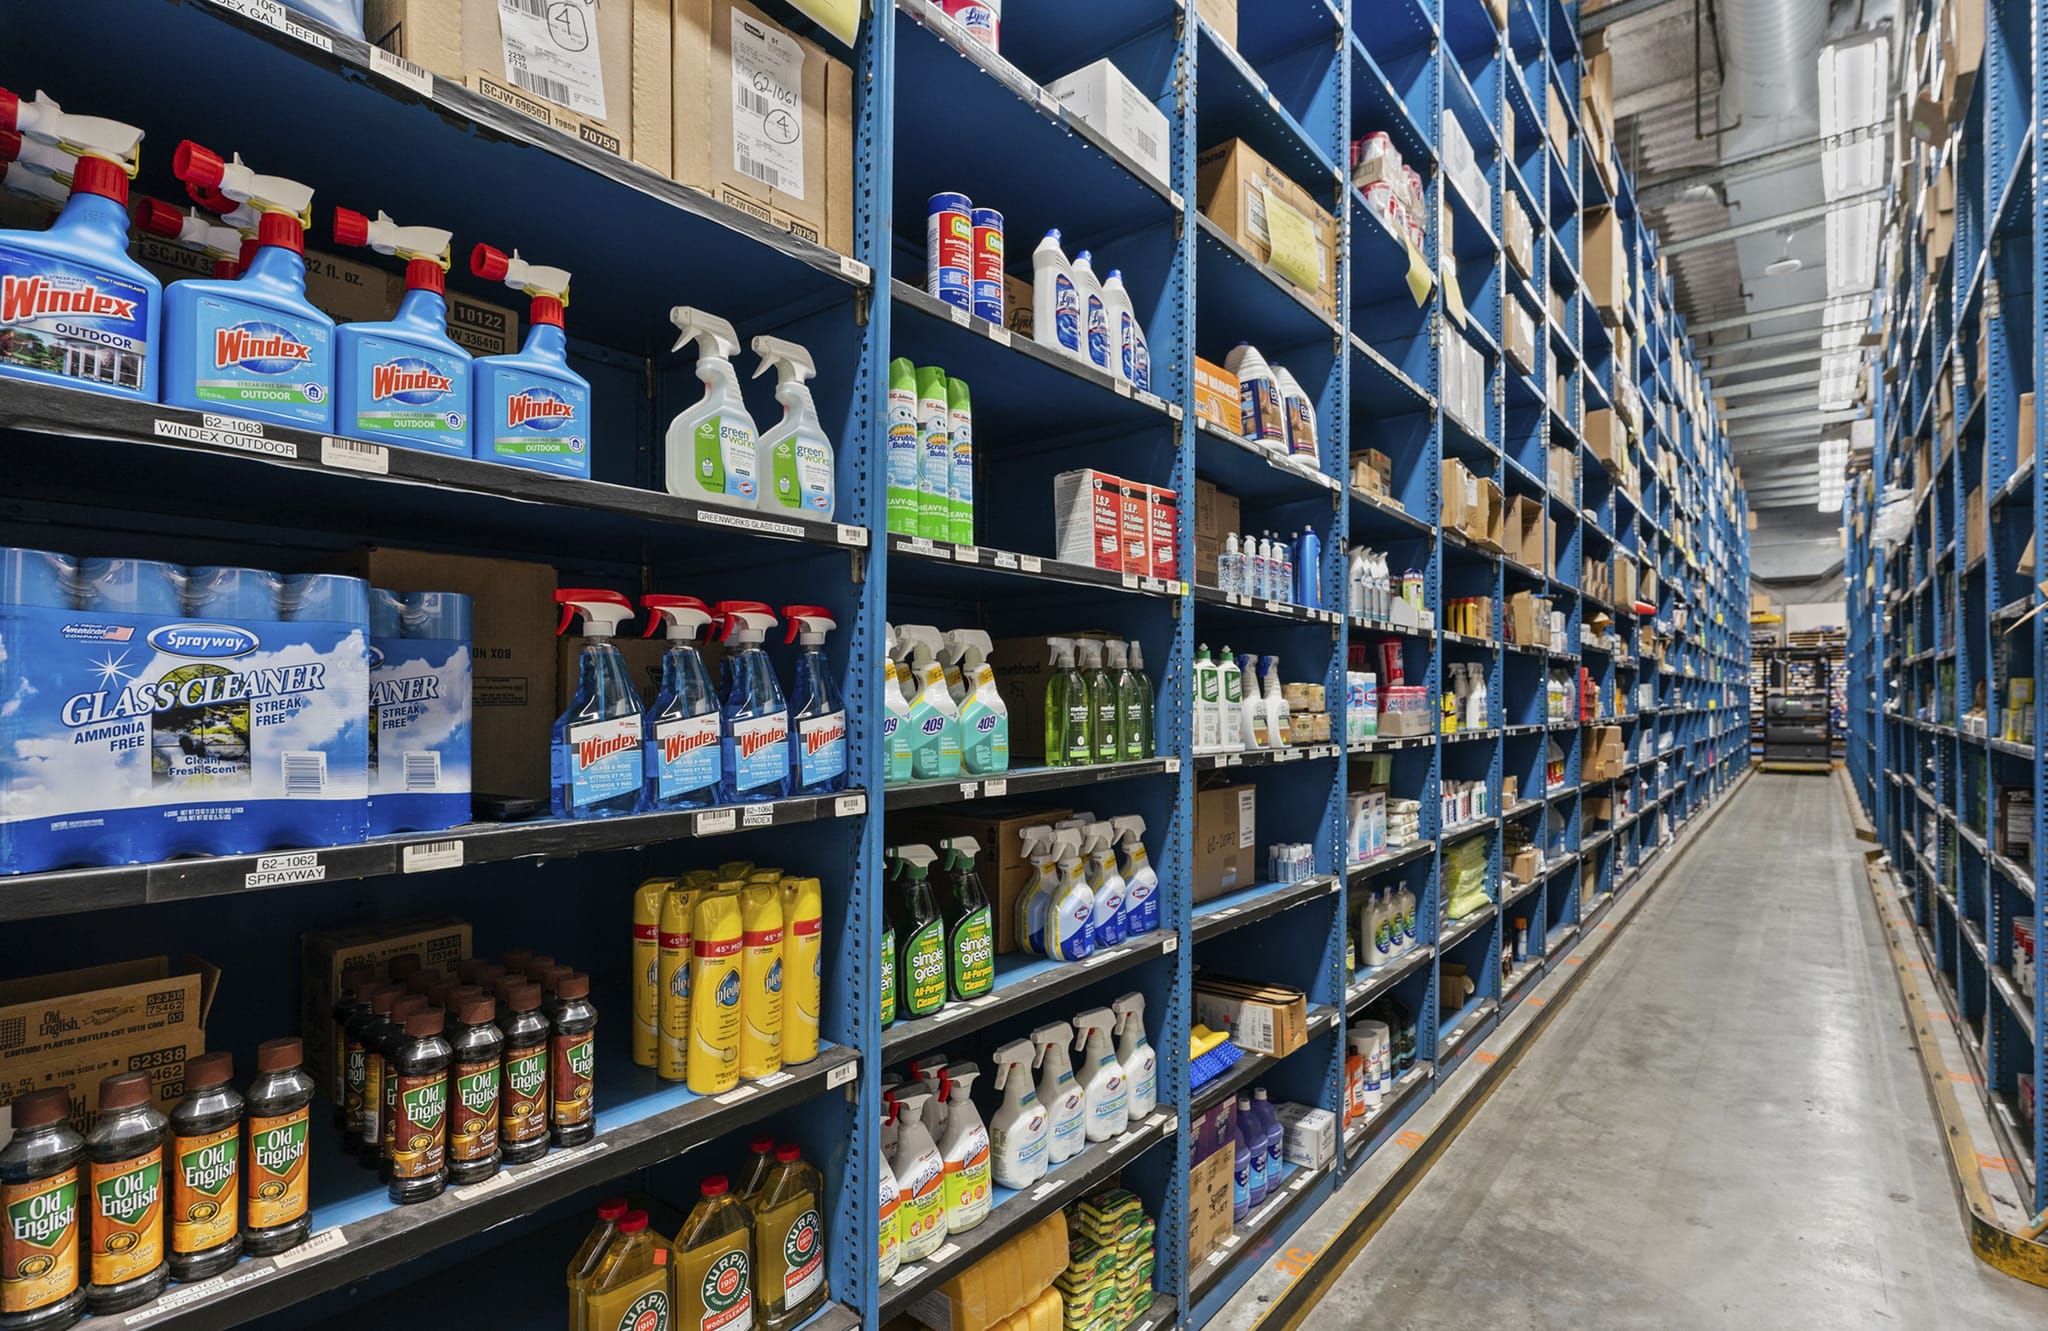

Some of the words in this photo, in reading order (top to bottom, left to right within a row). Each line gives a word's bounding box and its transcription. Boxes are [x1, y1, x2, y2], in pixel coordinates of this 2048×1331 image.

[555, 8, 571, 36] 4
[965, 7, 990, 25] Lysol
[249, 8, 281, 28] GAL.
[285, 21, 330, 50] REFILL
[752, 71, 798, 106] 62-1061
[483, 83, 514, 105] SCJW
[515, 98, 548, 121] 696503
[554, 117, 577, 132] 19800
[583, 127, 617, 151] 70759
[776, 115, 789, 138] 4
[726, 193, 746, 213] SCJW
[791, 224, 817, 242] 70759
[151, 244, 196, 268] SCJW
[326, 264, 340, 279] fl.
[344, 271, 364, 287] oz.
[2, 276, 137, 322] Windex
[457, 305, 502, 328] 10122
[55, 322, 132, 350] OUTDOOR
[463, 333, 500, 351] 336410
[216, 329, 312, 367] Windex
[374, 364, 451, 399] Windex
[240, 389, 291, 401] OUTDOOR
[508, 396, 574, 428] Windex
[204, 416, 262, 434] 62-1063
[393, 418, 436, 429] OUTDOOR
[720, 425, 750, 440] green
[159, 422, 220, 443] WINDEX
[223, 434, 295, 456] OUTDOOR
[525, 444, 561, 452] OUTDOOR
[728, 435, 756, 450] works
[796, 444, 825, 458] green
[803, 451, 831, 467] works
[698, 512, 750, 528] GREENWORKS
[751, 518, 774, 531] GLASS
[774, 522, 804, 536] CLEANER
[61, 625, 108, 636] American
[167, 632, 245, 650] Sprayway
[61, 680, 176, 728] GLASS
[178, 661, 326, 708] CLEANER
[255, 697, 302, 714] STREAK
[382, 705, 421, 719] STREAK
[255, 714, 286, 727] FREE
[382, 718, 407, 730] FREE
[922, 717, 944, 732] 409
[976, 715, 996, 730] 409
[74, 721, 145, 745] AMMONIA
[741, 726, 786, 760] Windex
[806, 725, 844, 757] Windex
[110, 735, 145, 752] FREE
[579, 732, 638, 770] Windex
[664, 729, 717, 765] Windex
[184, 755, 221, 766] Clean,
[168, 766, 201, 777] Fresh
[203, 765, 237, 775] Scent
[744, 816, 771, 826] WINDEX
[261, 855, 315, 870] 62-1062
[247, 867, 325, 887] SPRAYWAY
[714, 945, 730, 954] 45%
[960, 934, 992, 952] simple
[912, 948, 944, 968] simple
[962, 948, 992, 968] green
[914, 962, 944, 984] green
[964, 978, 987, 991] Cleaner
[148, 991, 185, 1005] 62338
[149, 1000, 184, 1014] 75462
[916, 995, 940, 1009] Cleaner
[43, 1010, 60, 1025] Old
[168, 1014, 183, 1023] 03
[43, 1038, 75, 1051] PLASTIC
[128, 1023, 146, 1034] WITH
[130, 1048, 186, 1071] 62338
[519, 1057, 538, 1075] Old
[56, 1070, 75, 1080] THIS
[77, 1065, 96, 1075] SIDE
[97, 1061, 109, 1070] UP
[151, 1065, 183, 1081] 462
[510, 1068, 545, 1093] English
[162, 1082, 184, 1099] 03
[472, 1071, 492, 1092] Old
[418, 1086, 439, 1106] Old
[462, 1083, 498, 1109] English
[407, 1096, 447, 1123] English
[267, 1127, 293, 1151] Old
[198, 1144, 225, 1170] Old
[256, 1141, 305, 1171] English
[185, 1158, 236, 1189] English
[114, 1171, 145, 1198] Old
[29, 1190, 61, 1219] Old
[101, 1184, 158, 1218] English
[13, 1206, 75, 1241] English
[786, 1210, 820, 1255] MURPHY
[800, 1234, 813, 1249] 1910
[1274, 1247, 1314, 1276] 3C
[704, 1251, 749, 1297] MURPHY
[720, 1275, 738, 1290] 1910
[788, 1270, 803, 1286] WOOD
[637, 1317, 656, 1331] 1910
[705, 1316, 725, 1331] WOOD
[725, 1300, 750, 1321] CLEANER
